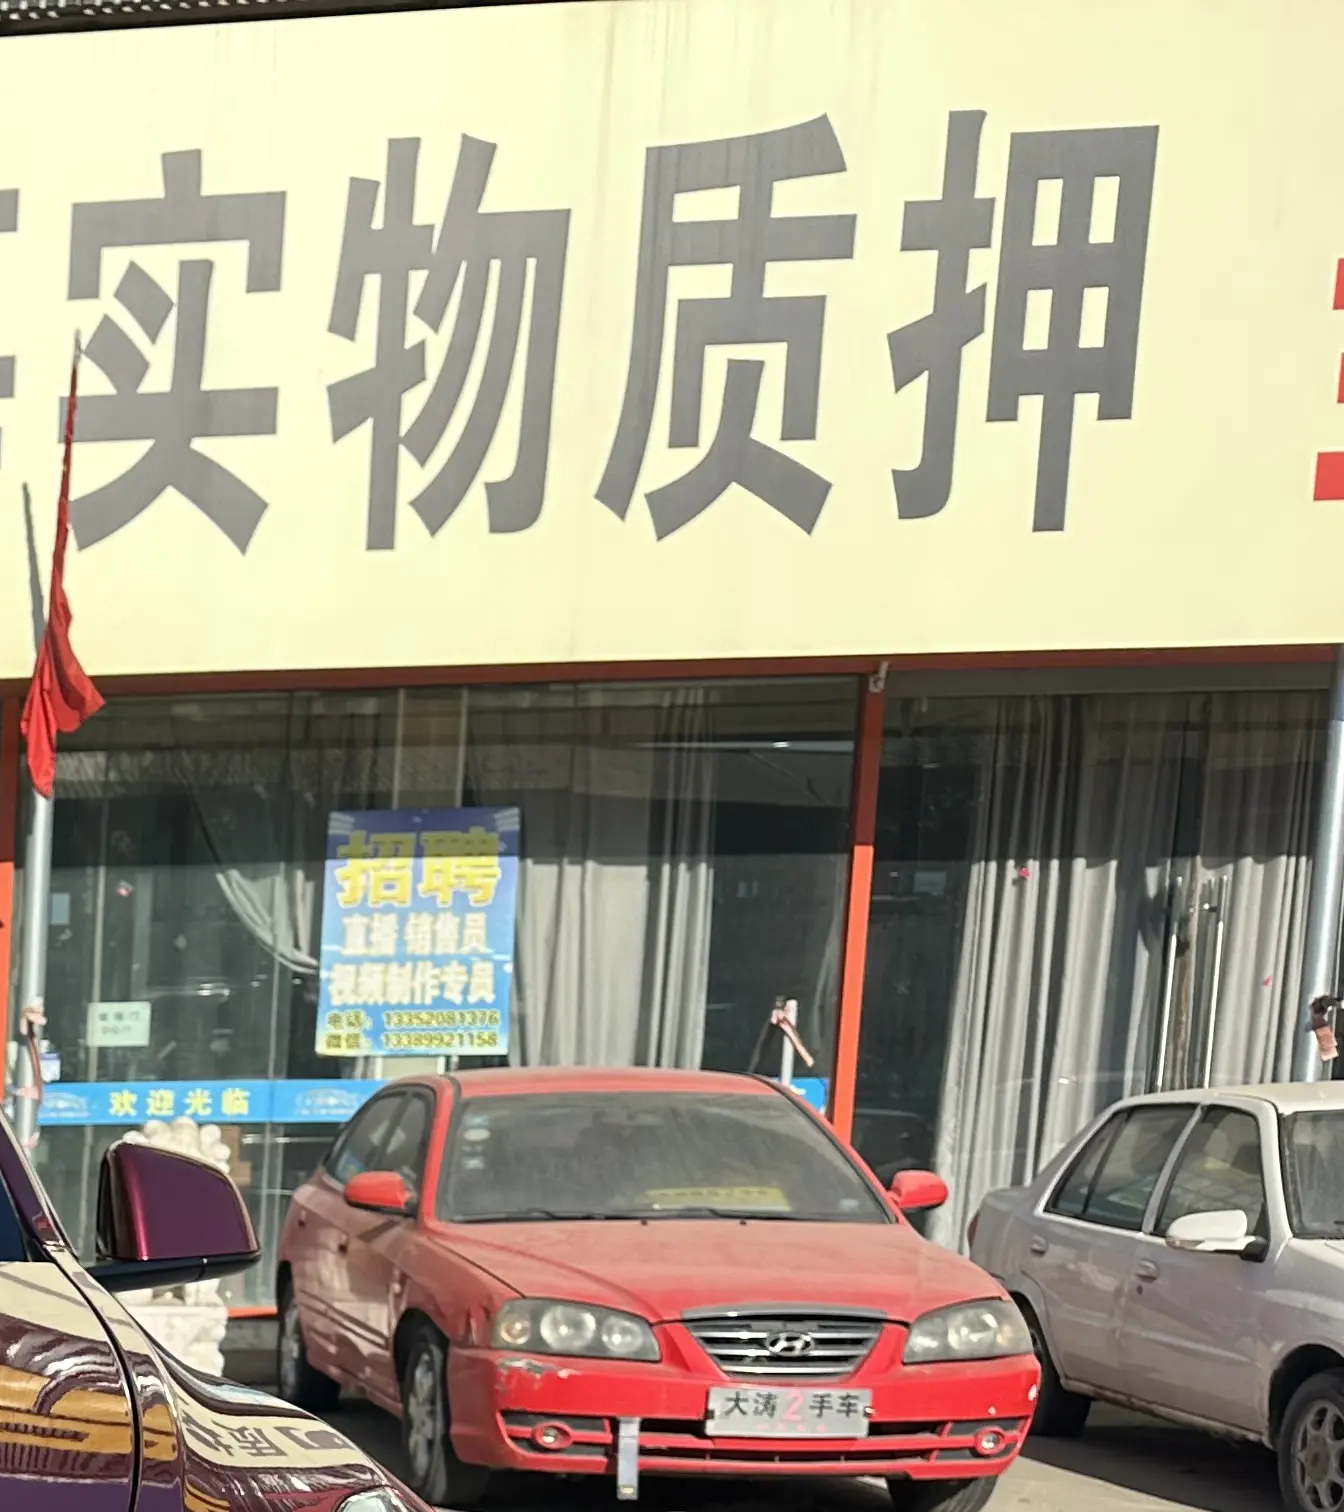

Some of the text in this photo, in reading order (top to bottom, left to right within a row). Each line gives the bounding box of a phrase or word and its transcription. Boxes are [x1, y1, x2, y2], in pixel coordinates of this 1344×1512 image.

[335, 827, 502, 907] 招聘
[109, 1088, 251, 1117] 欢迎光临
